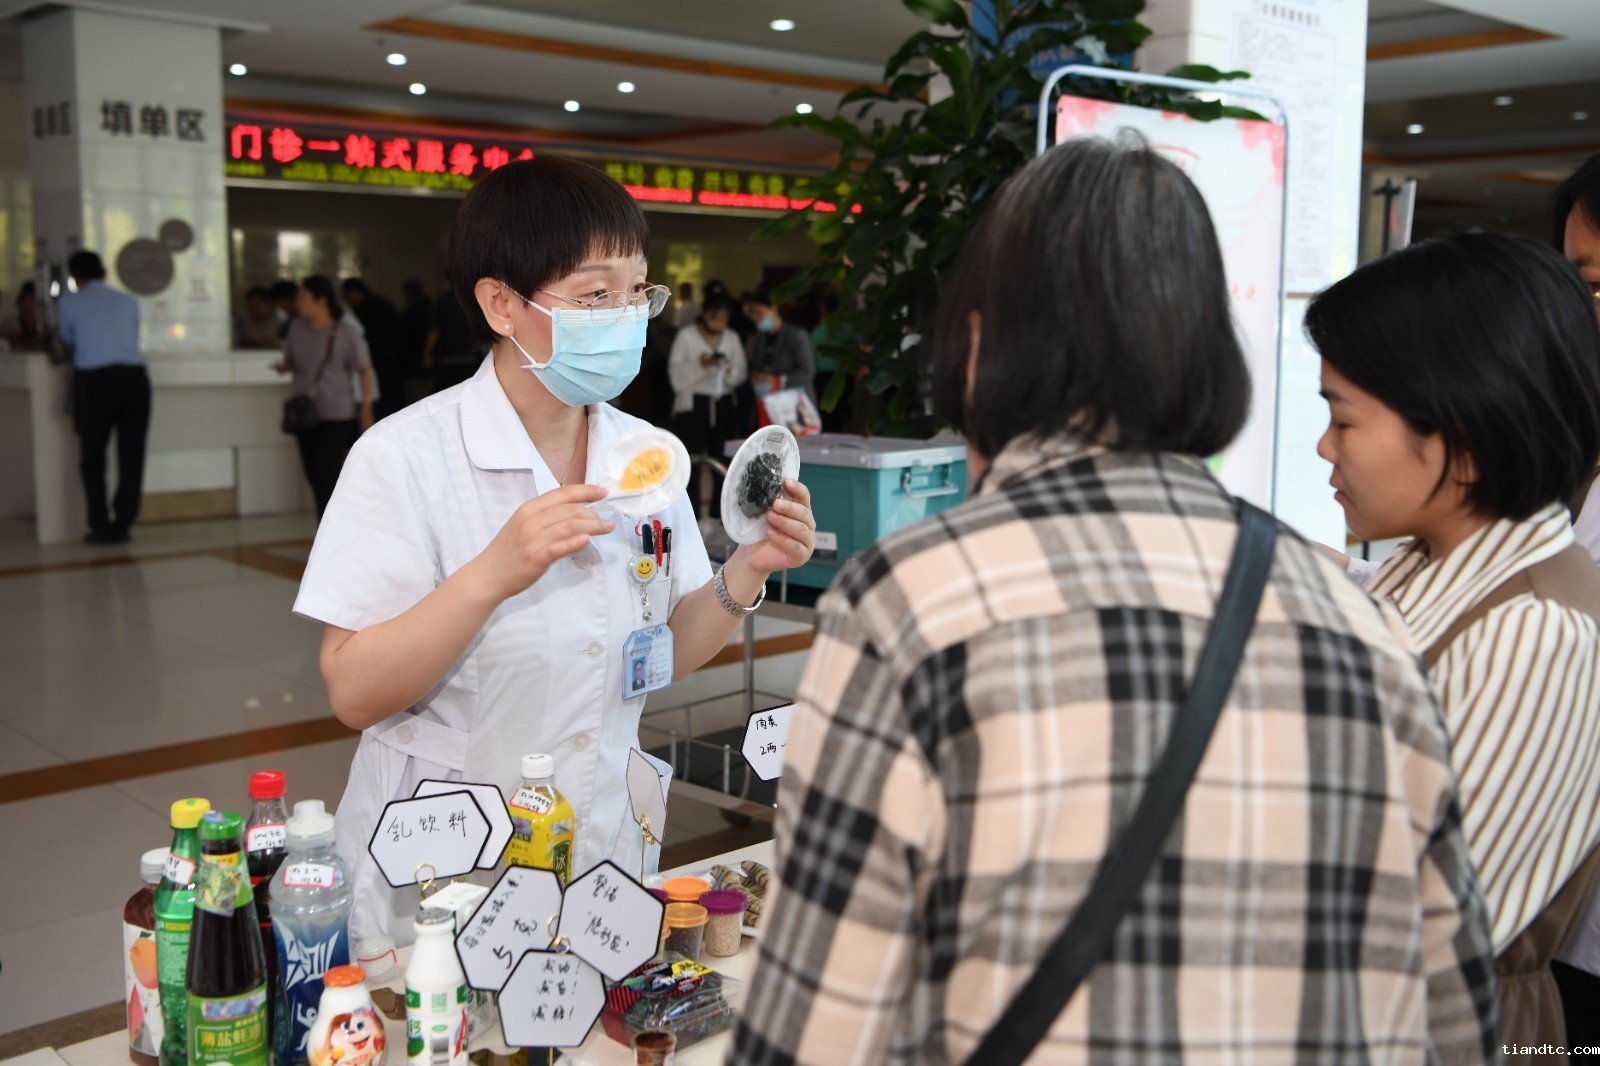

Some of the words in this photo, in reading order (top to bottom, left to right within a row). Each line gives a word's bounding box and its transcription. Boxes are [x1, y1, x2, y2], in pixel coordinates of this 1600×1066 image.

[99, 99, 207, 142] 填单区
[231, 124, 535, 176] 门诊一站式服务中
[387, 810, 468, 842] 乳饮料
